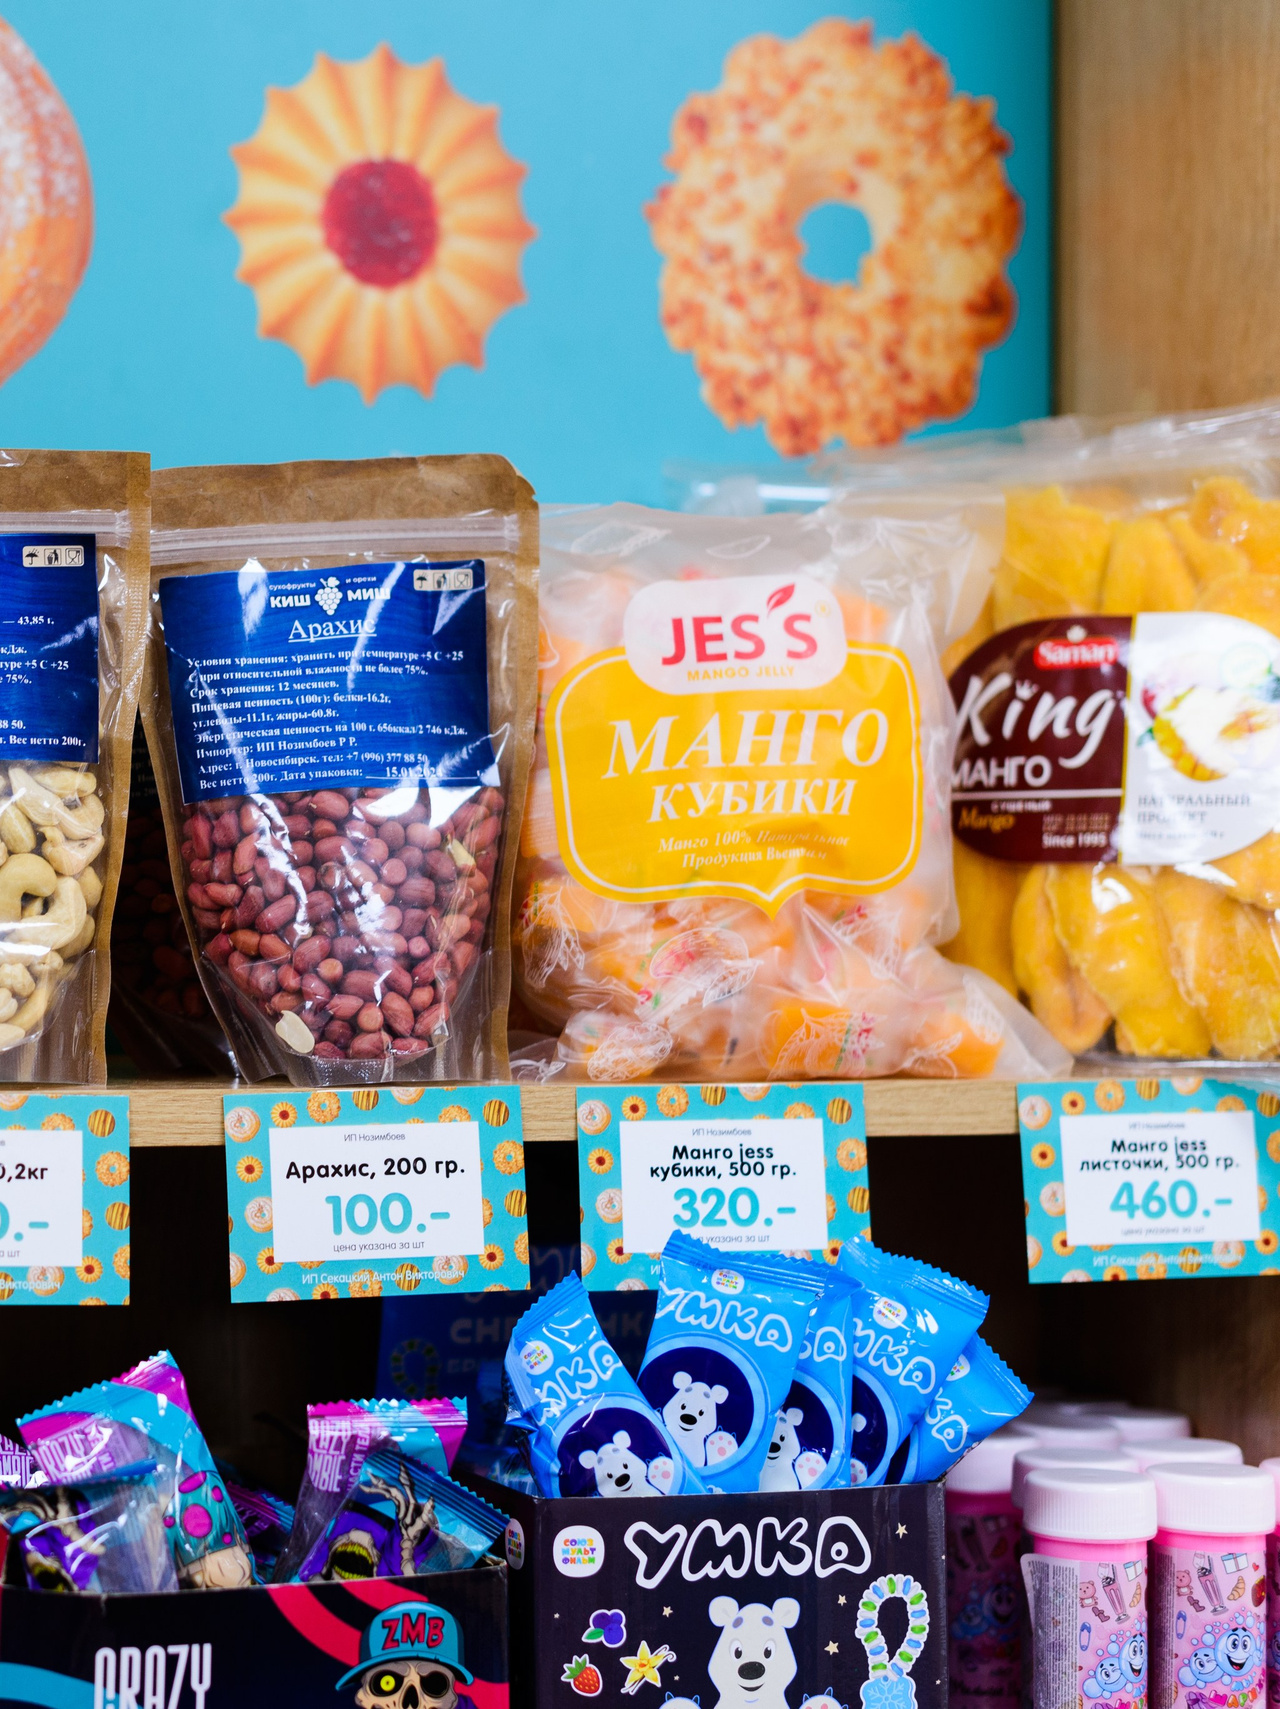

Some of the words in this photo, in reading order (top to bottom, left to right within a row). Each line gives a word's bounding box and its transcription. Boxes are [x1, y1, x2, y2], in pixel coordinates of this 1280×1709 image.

[269, 582, 316, 590] сухофрукты
[270, 595, 310, 608] КИШ
[347, 588, 390, 601] МИШ
[17, 616, 44, 625] 43,85
[288, 618, 376, 642] Арахис
[25, 660, 37, 669] +5
[51, 661, 69, 669] +25
[687, 667, 749, 682] MANGO
[755, 665, 795, 679] JELLY
[6, 674, 32, 684] 75%.
[11, 720, 26, 729] 50.
[955, 673, 1116, 769] King
[9, 735, 27, 744] Вес
[30, 736, 59, 745] нетто
[61, 736, 86, 747] 200г.
[602, 708, 888, 780] МАНГО
[647, 778, 858, 823] КУБИКИ
[658, 836, 708, 853] Манго
[715, 830, 751, 846] 100%
[1042, 833, 1075, 848] Since
[682, 850, 762, 870] Продукция
[344, 1134, 357, 1142] ИП
[358, 1133, 406, 1141] Нозимбоев
[707, 1128, 752, 1136] Нозимбоев
[673, 1145, 733, 1160] Манго
[738, 1144, 774, 1163] jess
[1111, 1140, 1168, 1153] Манго
[1174, 1137, 1207, 1156] jess
[285, 1161, 376, 1183] Арахис,
[384, 1157, 427, 1176] 200
[435, 1159, 465, 1178] гр.
[650, 1162, 721, 1181] кубики,
[729, 1162, 765, 1176] 500
[771, 1163, 796, 1179] гр.
[1079, 1159, 1168, 1172] листочки,
[1176, 1154, 1209, 1168] 500
[1215, 1156, 1240, 1171] гр.
[673, 1187, 796, 1229] 320.-
[1109, 1179, 1232, 1220] 460.-
[325, 1192, 451, 1236] 100.-
[334, 1243, 358, 1253] цена
[359, 1242, 397, 1253] указана
[399, 1242, 410, 1250] за
[412, 1241, 425, 1250] шт
[706, 1235, 743, 1244] указана
[758, 1234, 770, 1242] шт
[7, 1249, 20, 1257] шт
[0, 1278, 60, 1292] Викторович
[302, 1274, 318, 1285] ИП
[320, 1271, 370, 1285] Секацкий
[373, 1271, 403, 1282] Антон
[405, 1269, 464, 1282] Викторович
[655, 1280, 792, 1352] УМКА
[563, 1539, 594, 1547] СОЮЗ
[624, 1516, 871, 1589] УМКА
[382, 1612, 445, 1650] ZMB
